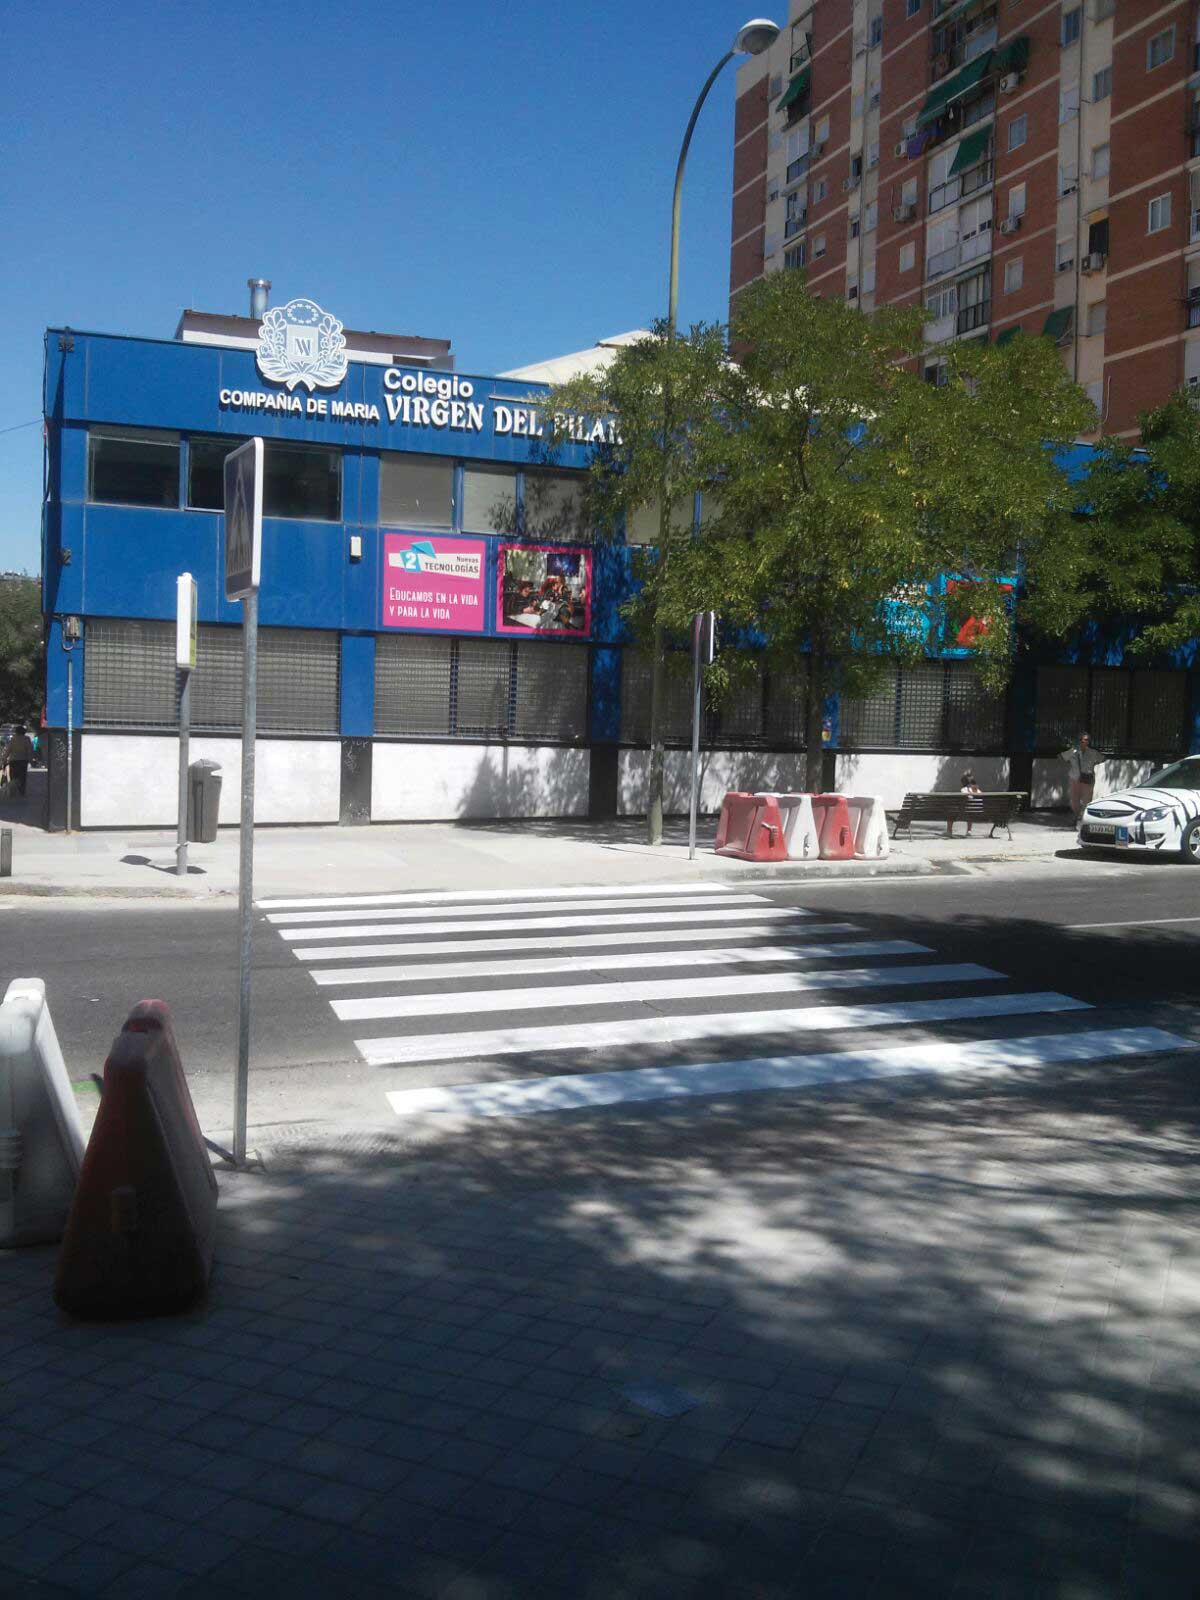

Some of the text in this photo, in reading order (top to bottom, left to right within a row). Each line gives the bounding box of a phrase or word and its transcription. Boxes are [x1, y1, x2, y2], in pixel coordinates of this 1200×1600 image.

[384, 368, 474, 400] Colegio
[219, 389, 380, 420] COMPAÑIA DE MARIA
[384, 394, 484, 431] VIRGEN
[494, 405, 543, 436] DEL
[405, 552, 417, 569] 2
[424, 562, 479, 574] TECNOLOGÍAS
[436, 592, 447, 604] EN
[449, 593, 459, 605] LA
[461, 594, 479, 606] VIDA
[397, 606, 418, 618] PARA
[420, 607, 431, 619] LA
[432, 608, 450, 621] VIDA
